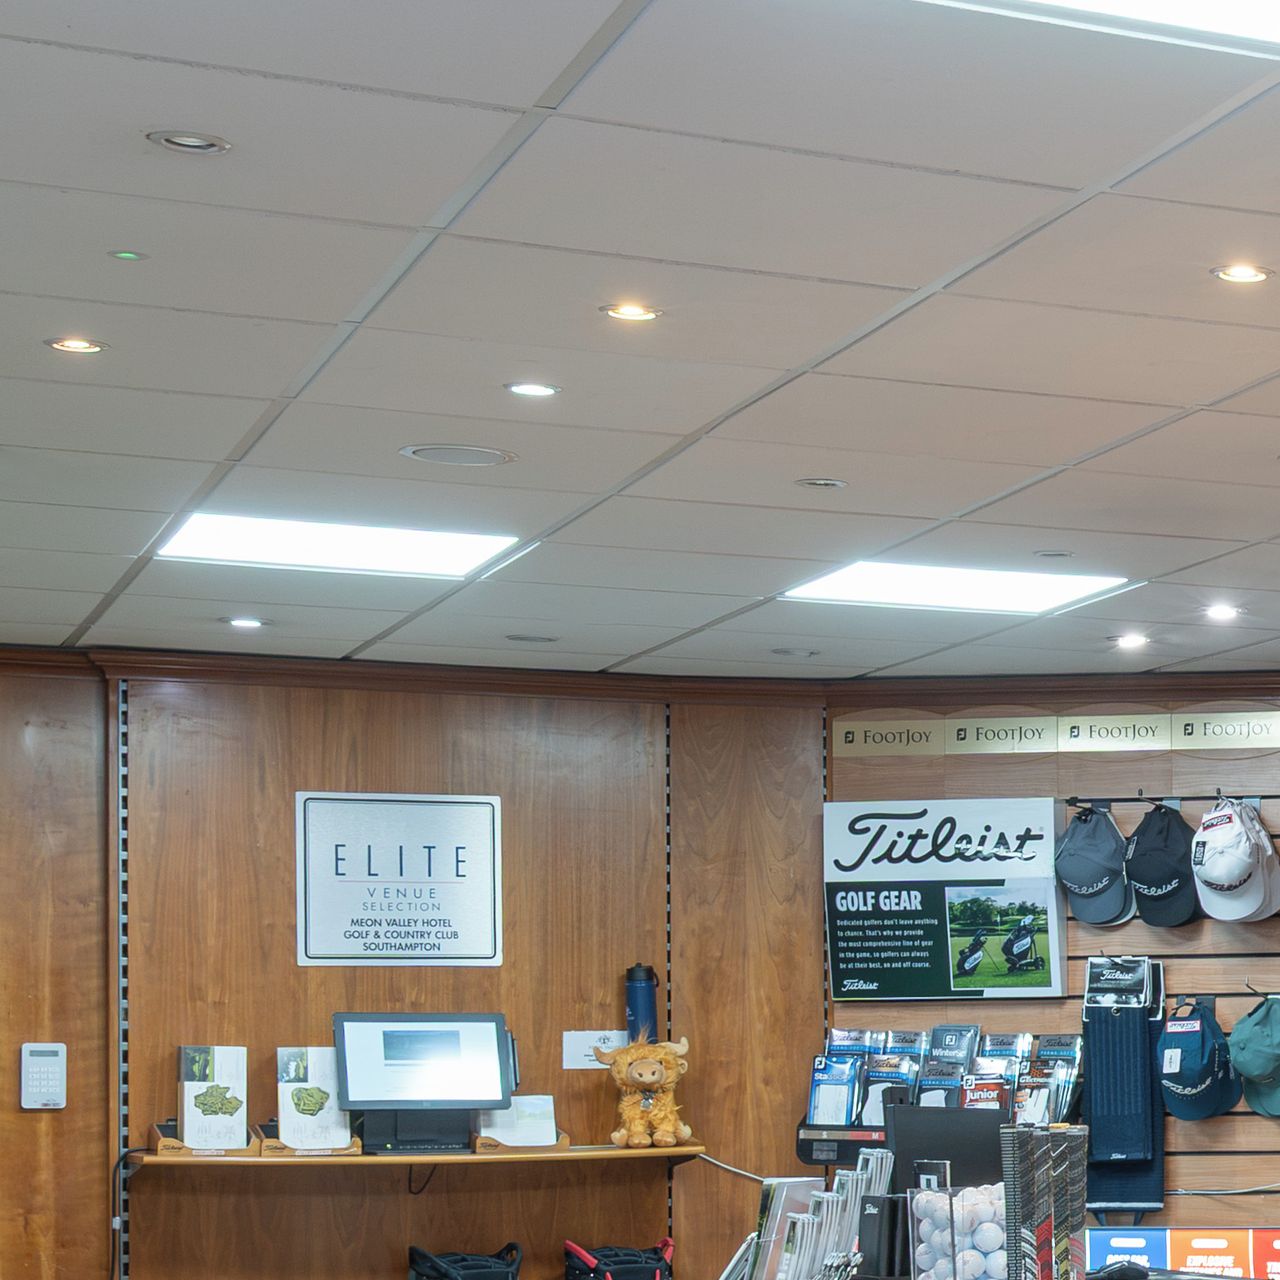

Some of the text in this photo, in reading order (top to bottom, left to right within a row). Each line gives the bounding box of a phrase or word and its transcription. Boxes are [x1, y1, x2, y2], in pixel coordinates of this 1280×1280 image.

[834, 808, 1044, 872] Titleist
[335, 844, 466, 877] ELITE
[1062, 876, 1110, 895] Titleist
[1131, 879, 1179, 896] Titleist
[368, 888, 436, 898] VENUE
[362, 902, 441, 912] SELECTION
[836, 890, 922, 912] GOLF GEAR
[350, 918, 452, 927] MEON VALLEY HOTEL
[344, 931, 458, 940] GOLF & COUNTRY CLUB
[363, 942, 441, 952] SOUTHAMPTON
[1100, 970, 1134, 980] Titleist
[841, 979, 879, 991] Titleist
[1161, 1077, 1212, 1094] Titleist
[966, 1089, 999, 1102] Junior
